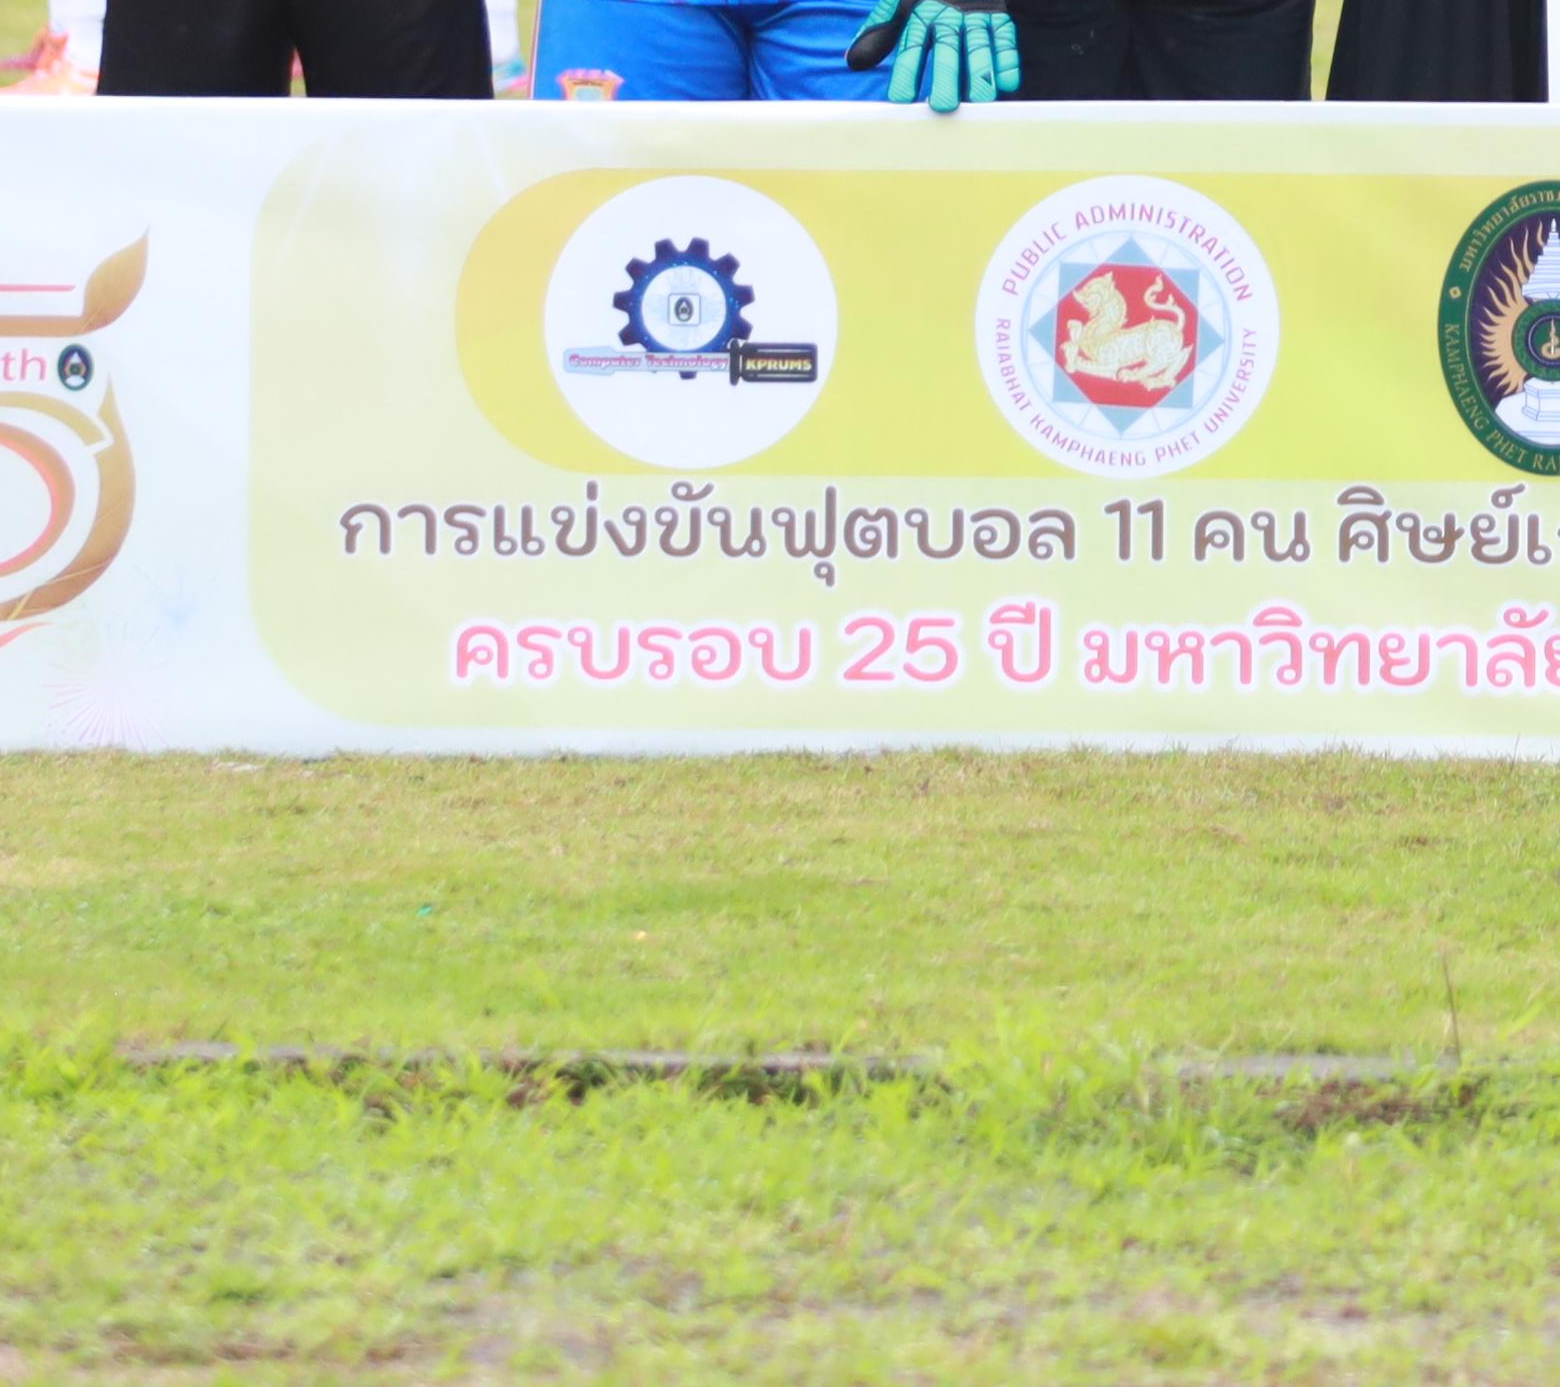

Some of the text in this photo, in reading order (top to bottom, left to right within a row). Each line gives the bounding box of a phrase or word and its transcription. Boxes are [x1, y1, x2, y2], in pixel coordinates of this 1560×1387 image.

[1002, 202, 1254, 302] PUBLIC ADMINISTRATION
[568, 353, 642, 369] Computer
[745, 358, 813, 372] KPRUMS
[1029, 413, 1146, 467] KAMPHAENG
[1155, 431, 1201, 463] PHET
[1203, 327, 1257, 434] UNIVERSITY
[1444, 323, 1490, 431] KAMPHAENG
[1486, 429, 1526, 463] PHET
[340, 481, 1077, 587] การแข่งขันฟุตบอล
[1104, 498, 1164, 562] 11
[1193, 502, 1311, 563] คน
[454, 621, 811, 684] ครบรอบ
[842, 616, 959, 684] 25
[986, 601, 1050, 683] ปี
